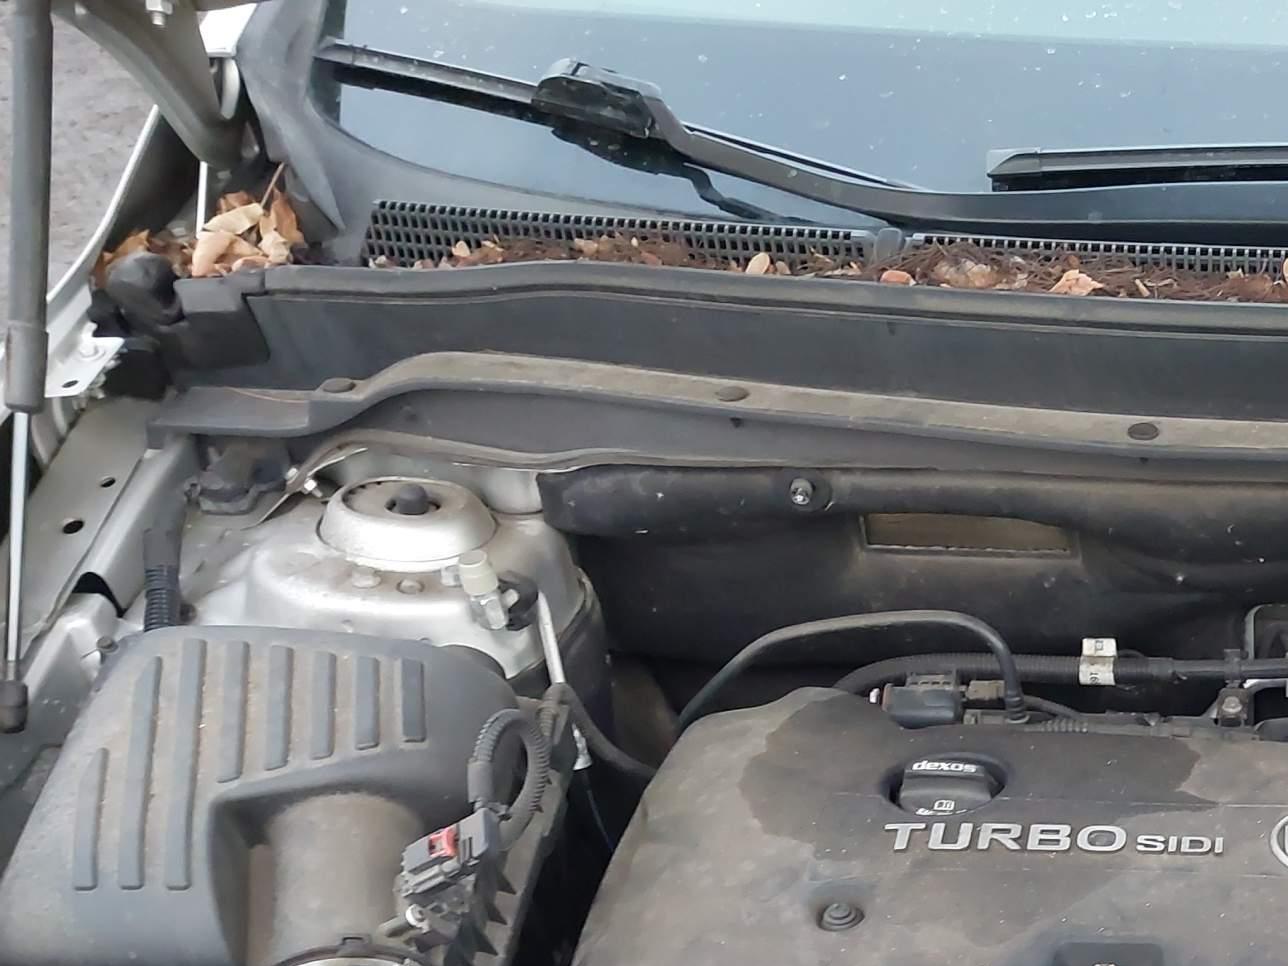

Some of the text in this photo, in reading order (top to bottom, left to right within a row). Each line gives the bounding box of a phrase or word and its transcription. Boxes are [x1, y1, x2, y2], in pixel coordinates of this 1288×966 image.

[912, 759, 979, 773] dexos
[884, 822, 1225, 855] TURBO SIDI
